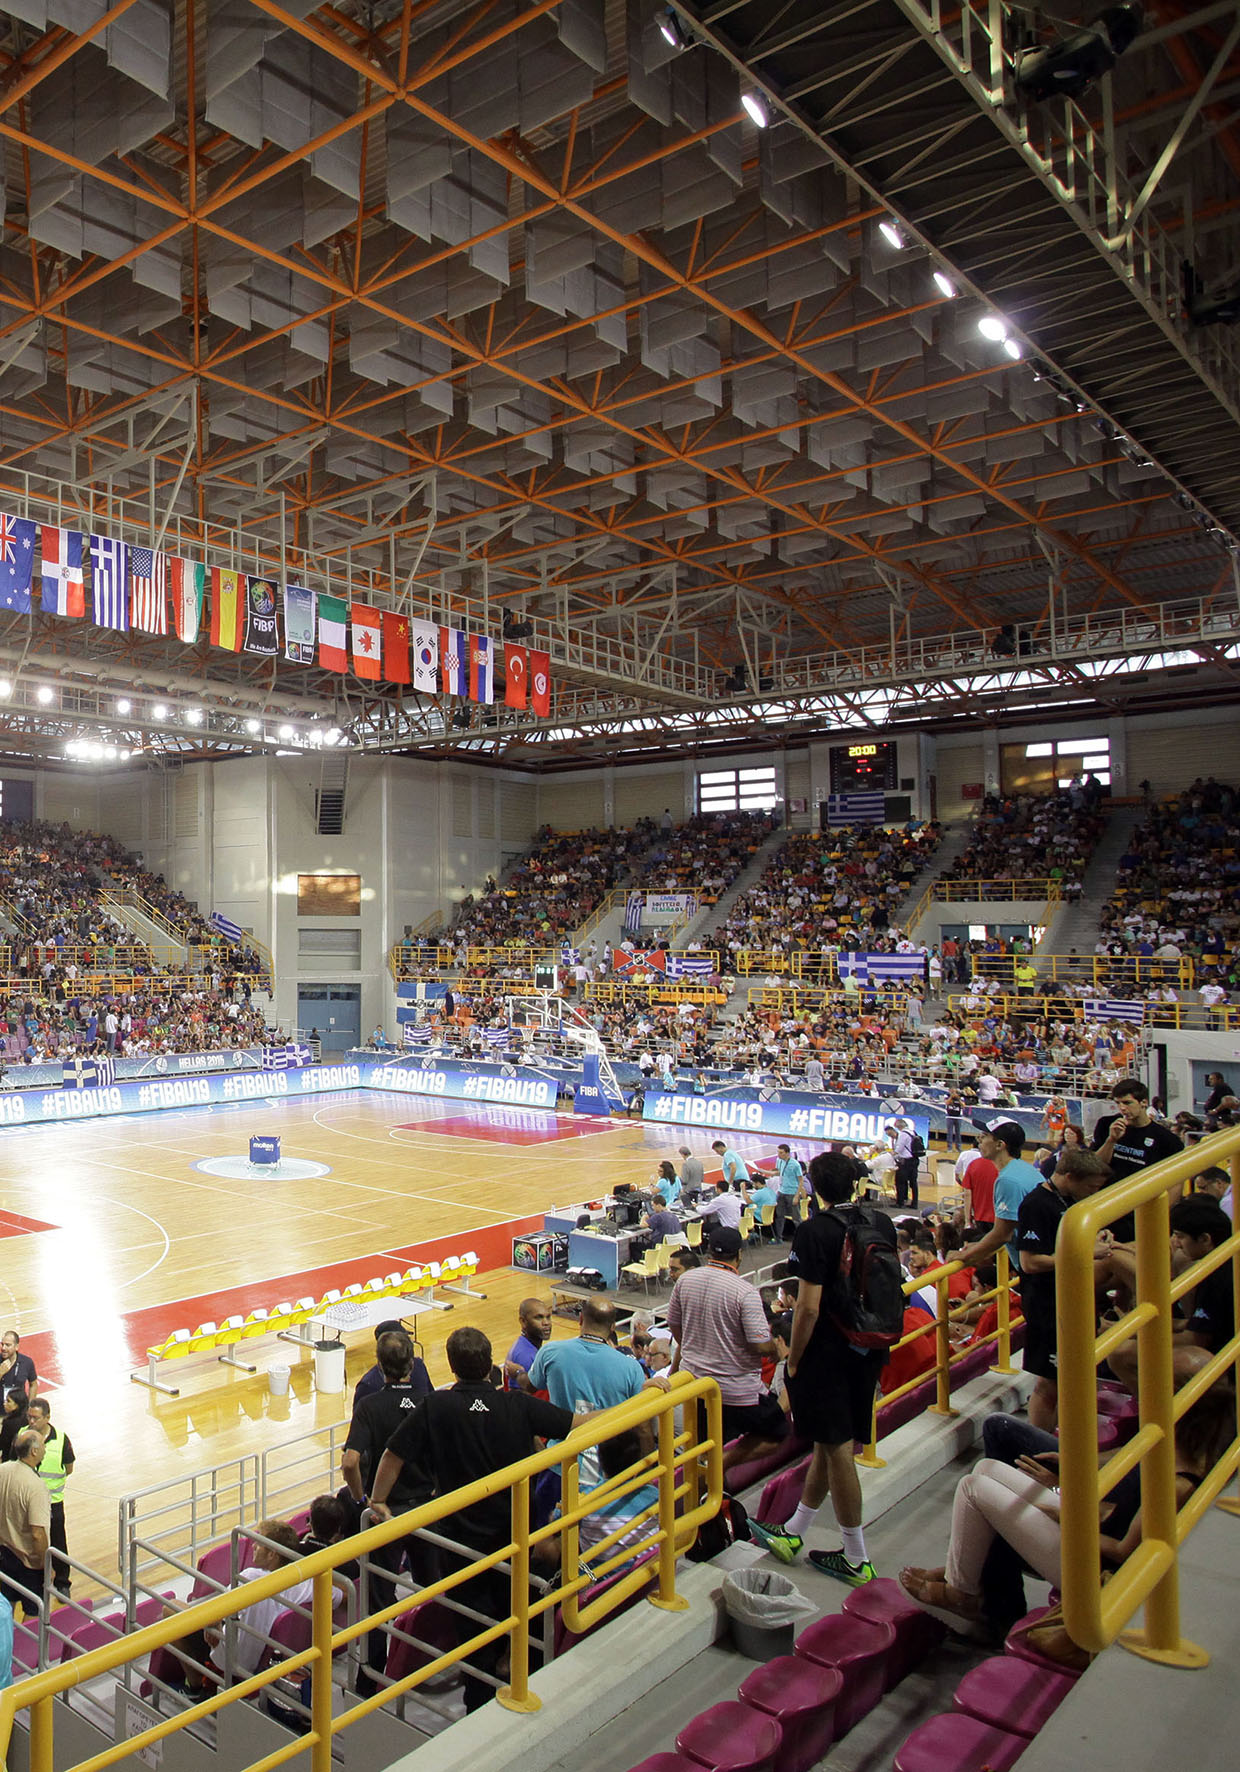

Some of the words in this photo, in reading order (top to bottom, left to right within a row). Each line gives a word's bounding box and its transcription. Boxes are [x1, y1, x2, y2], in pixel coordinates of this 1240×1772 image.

[849, 745, 876, 757] 20:00
[179, 1056, 206, 1069] HELLAS
[223, 1071, 288, 1097] #FIBAU19
[301, 1065, 360, 1089] #FIBAU19
[370, 1067, 447, 1093] #FIBAU19
[463, 1076, 548, 1103] #FIBAU19
[41, 1087, 121, 1116] #FIBAU19
[138, 1079, 210, 1107] #FIBAU19
[580, 1085, 599, 1097] FIBA
[654, 1095, 763, 1130] #FIBAU19
